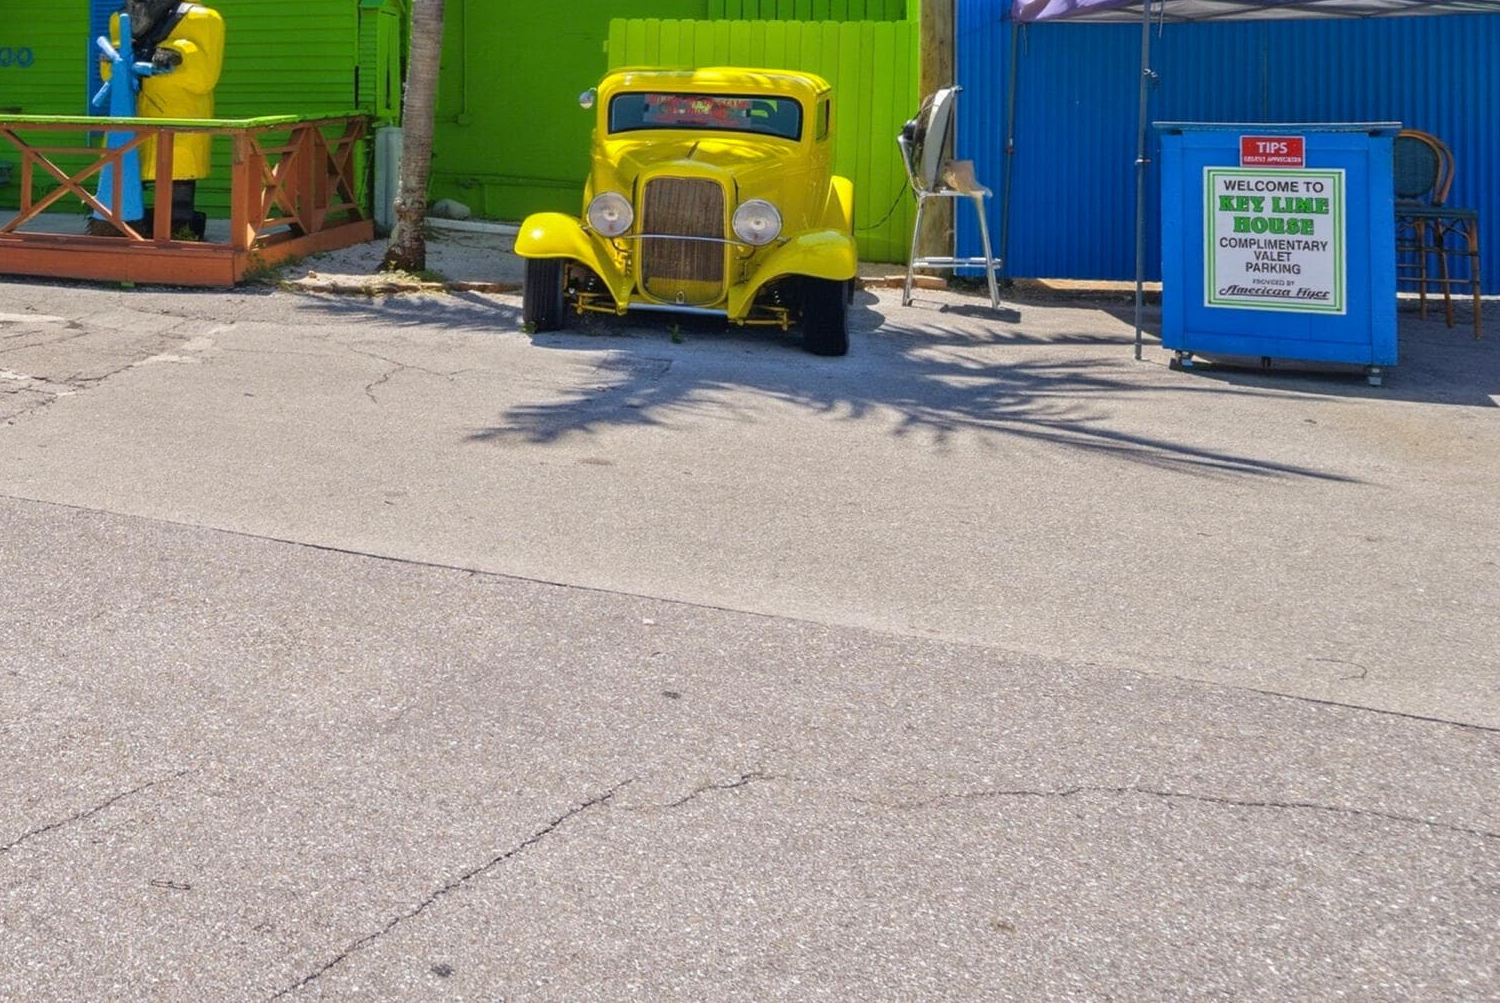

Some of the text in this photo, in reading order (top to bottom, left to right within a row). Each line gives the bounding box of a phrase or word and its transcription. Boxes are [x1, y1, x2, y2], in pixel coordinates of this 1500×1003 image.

[1256, 141, 1288, 154] TIPS
[1223, 179, 1324, 194] WELCOME TO
[1219, 195, 1329, 215] KEY LIME
[1233, 216, 1315, 235] HOUSE
[1219, 236, 1329, 252] COMPLIMENTARY
[1254, 250, 1292, 262] VALET
[1245, 261, 1302, 275] PARKING
[1218, 284, 1292, 297] American
